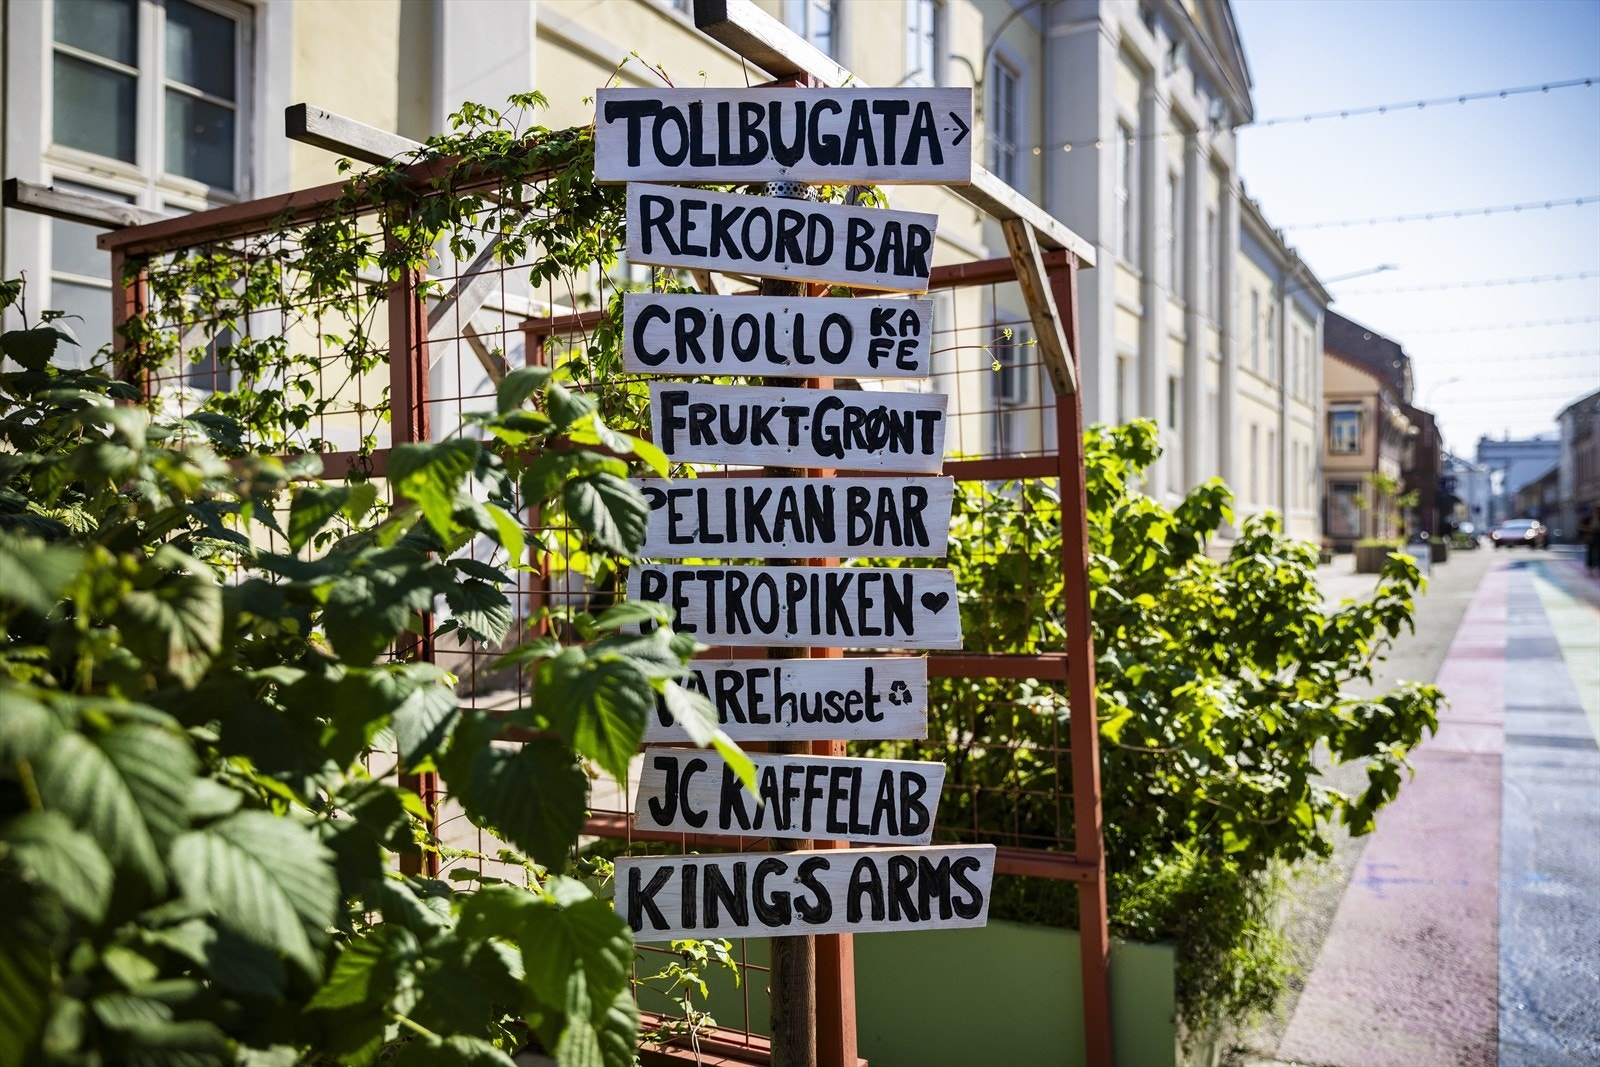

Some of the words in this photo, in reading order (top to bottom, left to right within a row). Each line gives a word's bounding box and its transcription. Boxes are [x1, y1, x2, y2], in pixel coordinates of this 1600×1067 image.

[604, 99, 943, 167] TOLLBUGATA
[640, 194, 834, 266] REKORD
[845, 217, 931, 278] BAR
[632, 304, 853, 367] CRIOLLO
[867, 337, 919, 371] FE
[869, 307, 921, 338] KA
[846, 485, 931, 548] BAR
[638, 569, 915, 638] RETROPIKEN
[647, 755, 709, 829] JC
[718, 761, 930, 838] KAFFELAB
[627, 856, 833, 932] KINGS
[846, 855, 984, 924] ARMS
